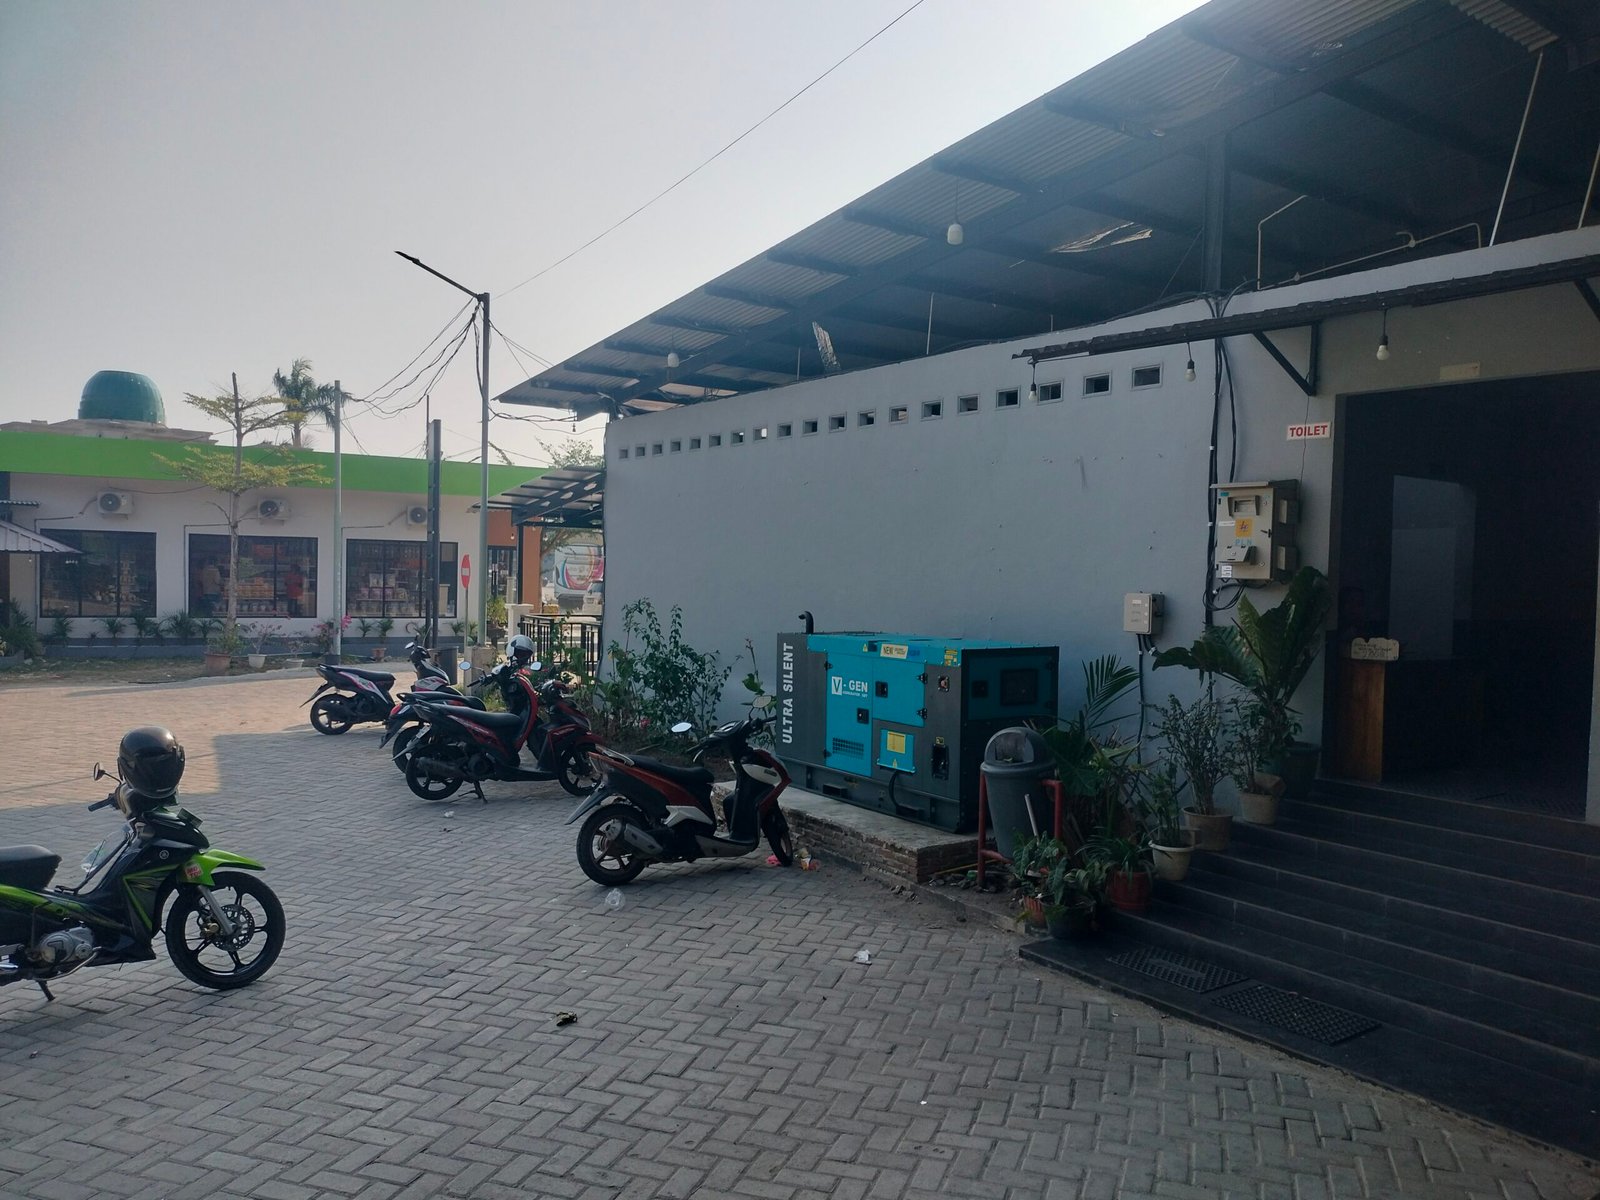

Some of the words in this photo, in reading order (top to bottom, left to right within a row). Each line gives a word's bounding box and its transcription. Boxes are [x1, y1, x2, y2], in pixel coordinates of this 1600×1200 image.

[1289, 425, 1328, 437] TOILET
[782, 642, 794, 692] SILENT
[848, 679, 868, 693] GEN
[782, 698, 793, 744] ULTRA
